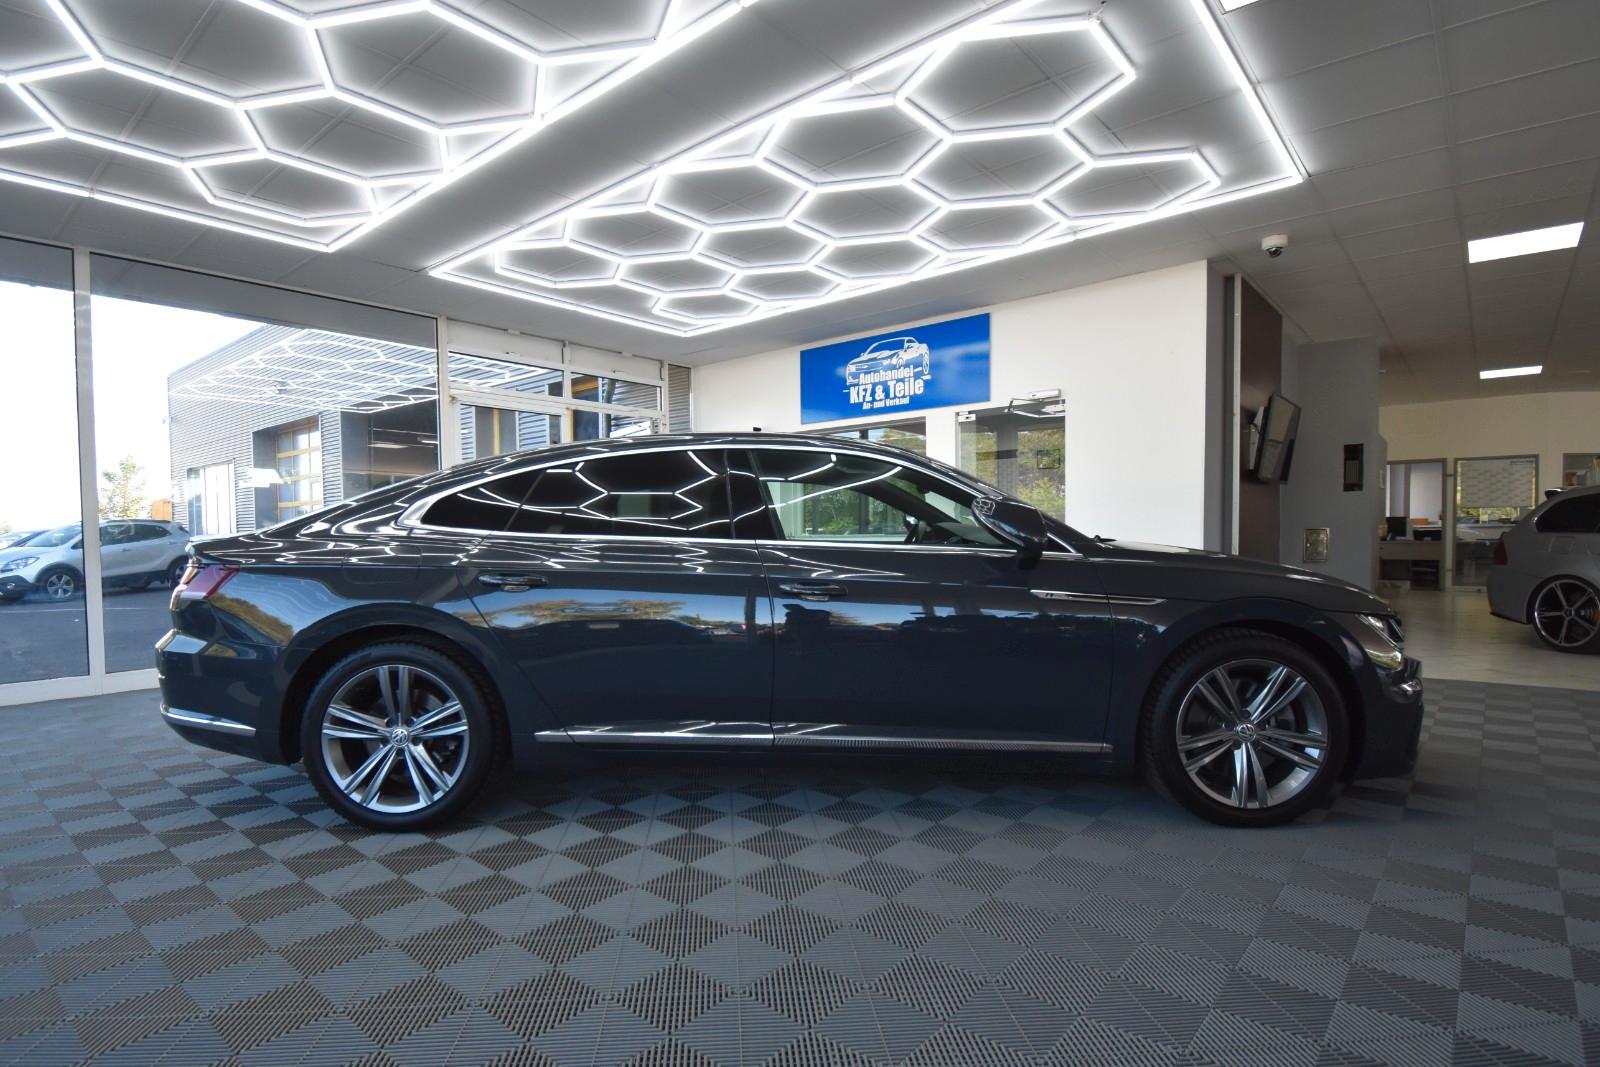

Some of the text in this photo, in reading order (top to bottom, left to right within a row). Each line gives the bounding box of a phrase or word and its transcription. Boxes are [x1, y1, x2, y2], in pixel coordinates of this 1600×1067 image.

[859, 365, 914, 384] Autohandel
[850, 377, 924, 404] KFZ & Teile
[862, 396, 909, 410] An- und Verkauf
